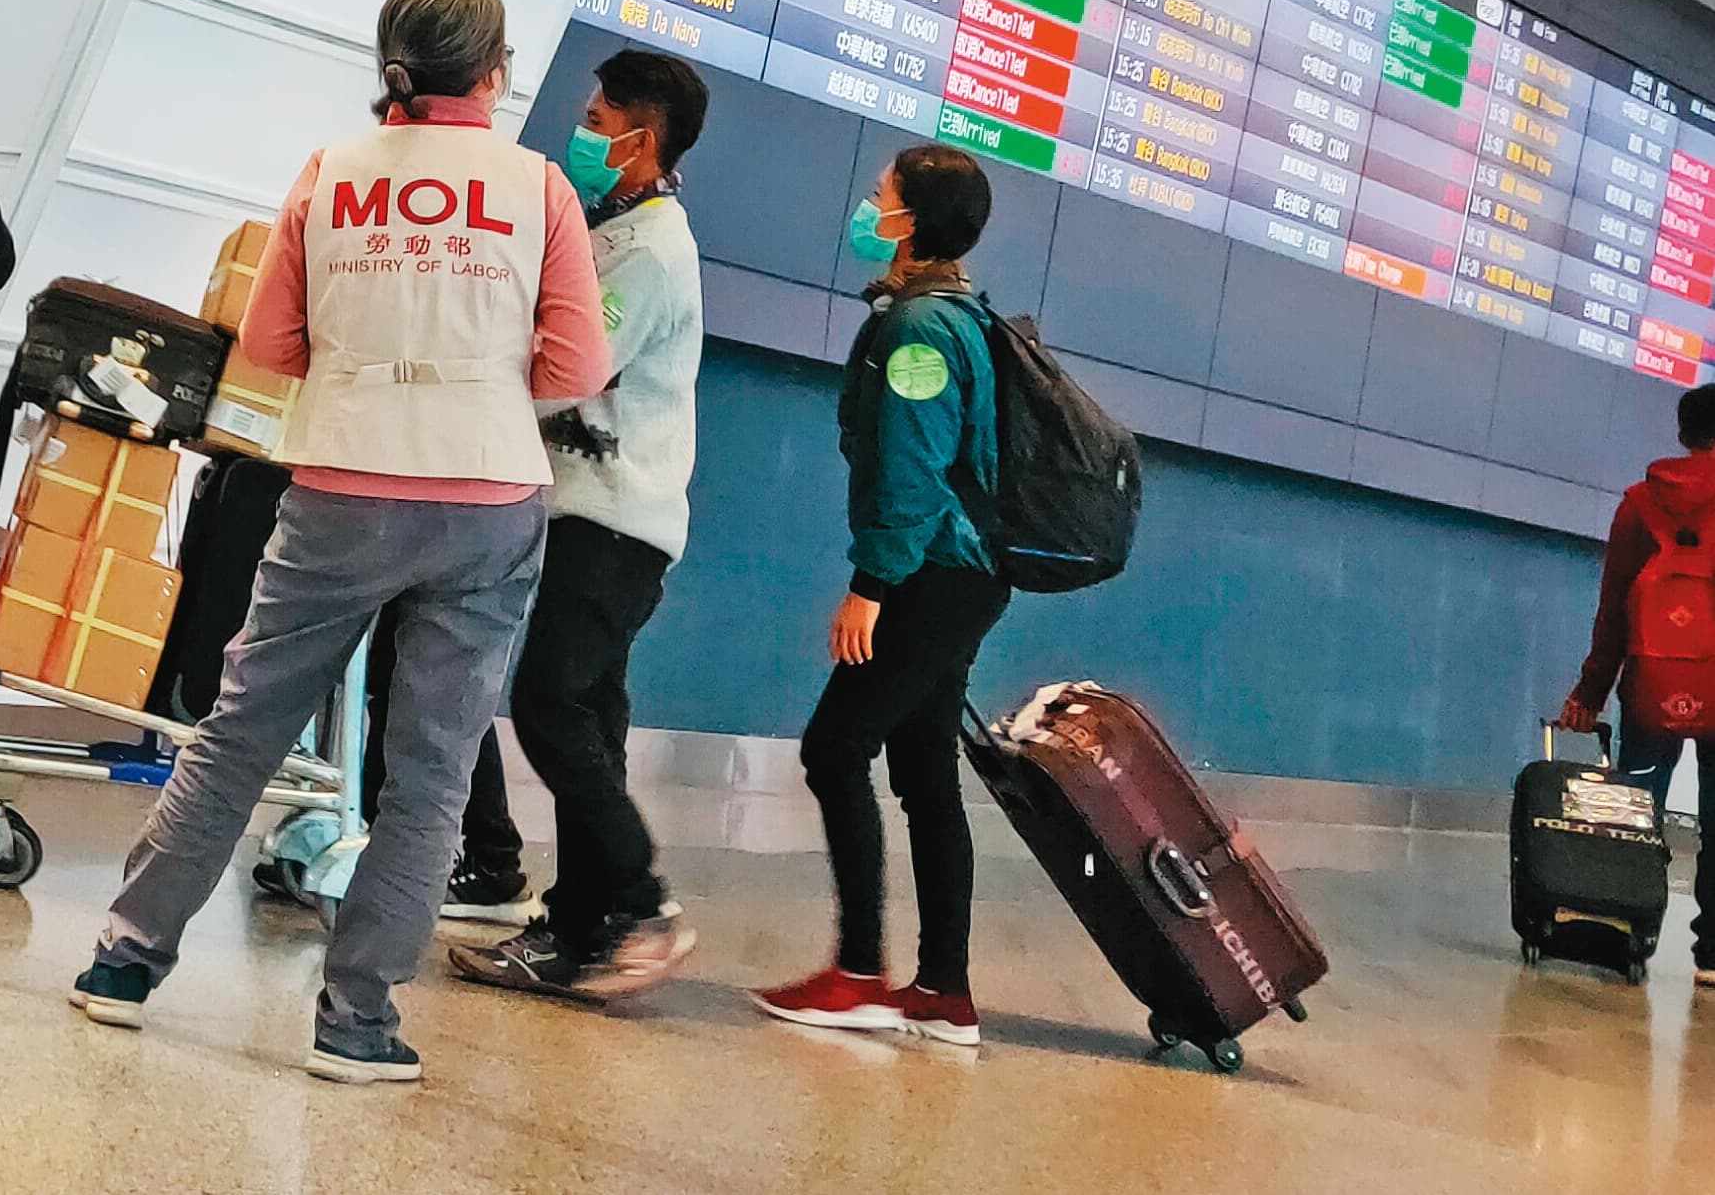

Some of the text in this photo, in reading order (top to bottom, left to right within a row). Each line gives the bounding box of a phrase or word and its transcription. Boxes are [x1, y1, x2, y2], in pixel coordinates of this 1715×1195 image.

[651, 9, 669, 36] Da
[671, 17, 702, 48] Nang
[1123, 16, 1153, 47] 15:15
[836, 29, 888, 69] 中華航空
[1115, 53, 1146, 82] 15:25
[1107, 89, 1138, 118] 15:25
[1100, 125, 1131, 154] 15:25
[331, 177, 514, 236] MOL
[365, 233, 472, 257] 勞動部
[329, 259, 511, 282] MINISTRY OF LABOR
